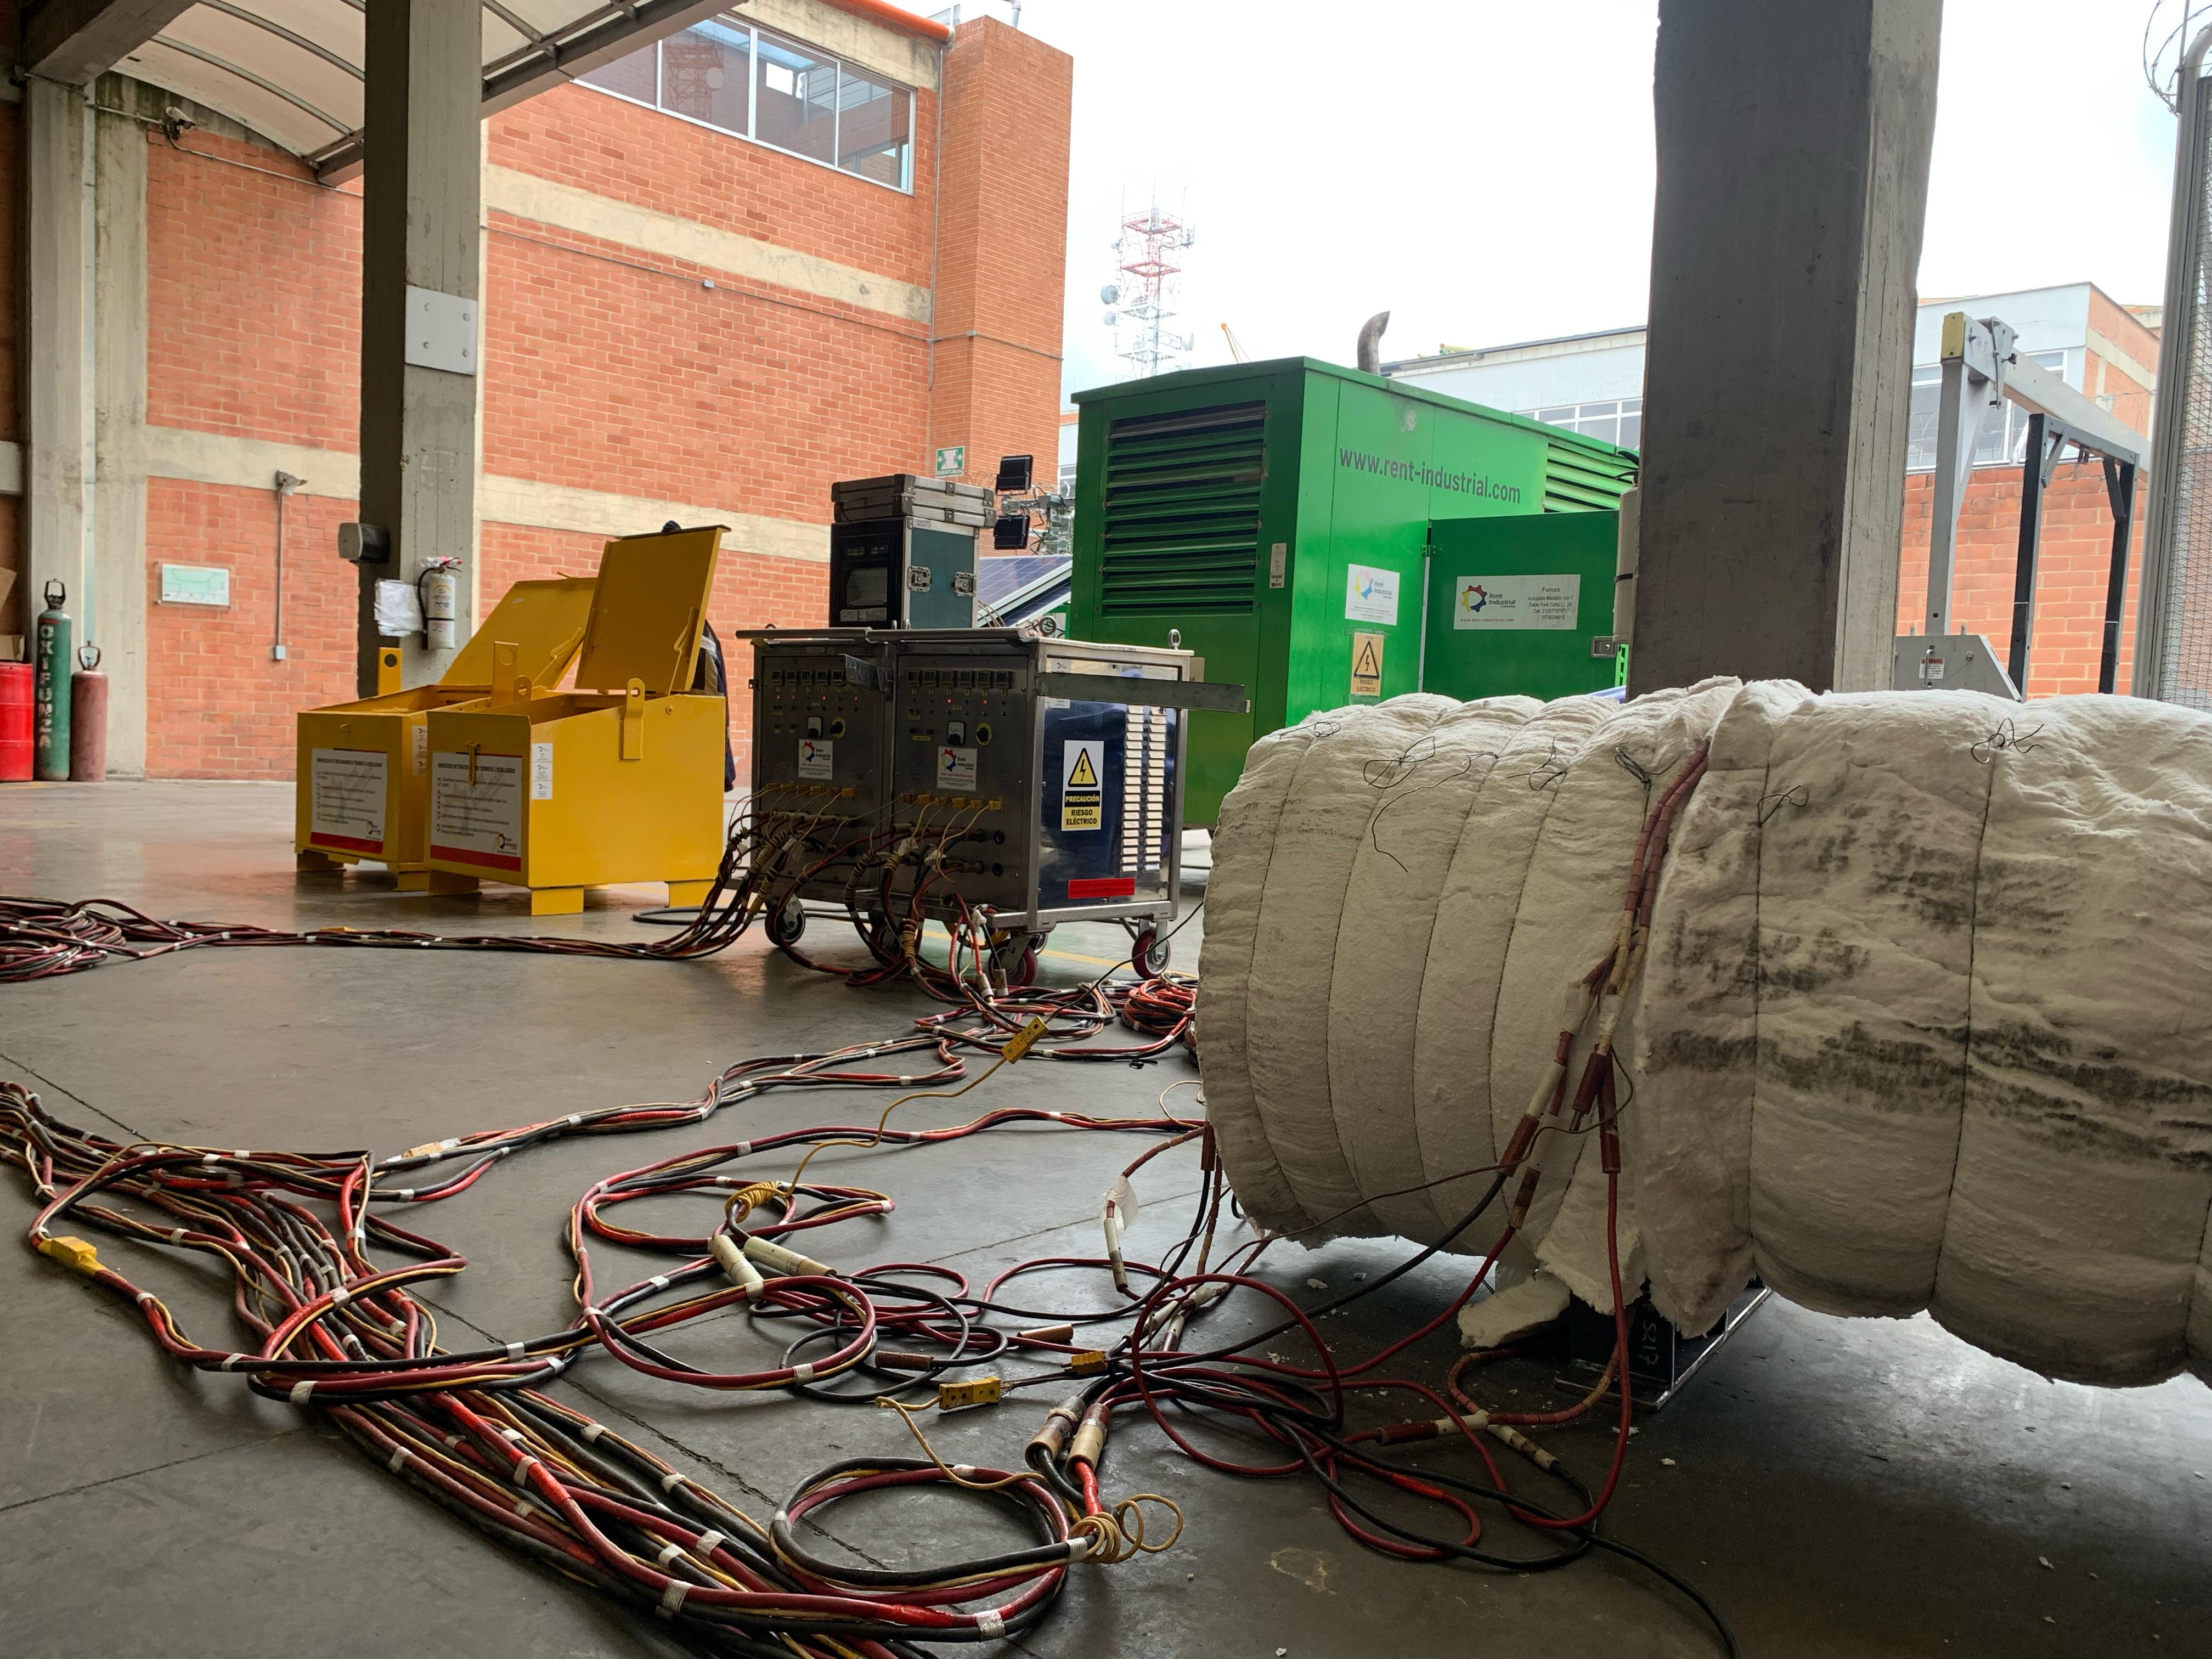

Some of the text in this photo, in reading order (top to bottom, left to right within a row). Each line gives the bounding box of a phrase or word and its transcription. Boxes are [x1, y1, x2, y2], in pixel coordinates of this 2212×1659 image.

[1340, 448, 1520, 504] www.rent-industrial.com
[1065, 794, 1100, 803] PRECAUCIÓN
[1066, 816, 1097, 825] ELÉCTRICO
